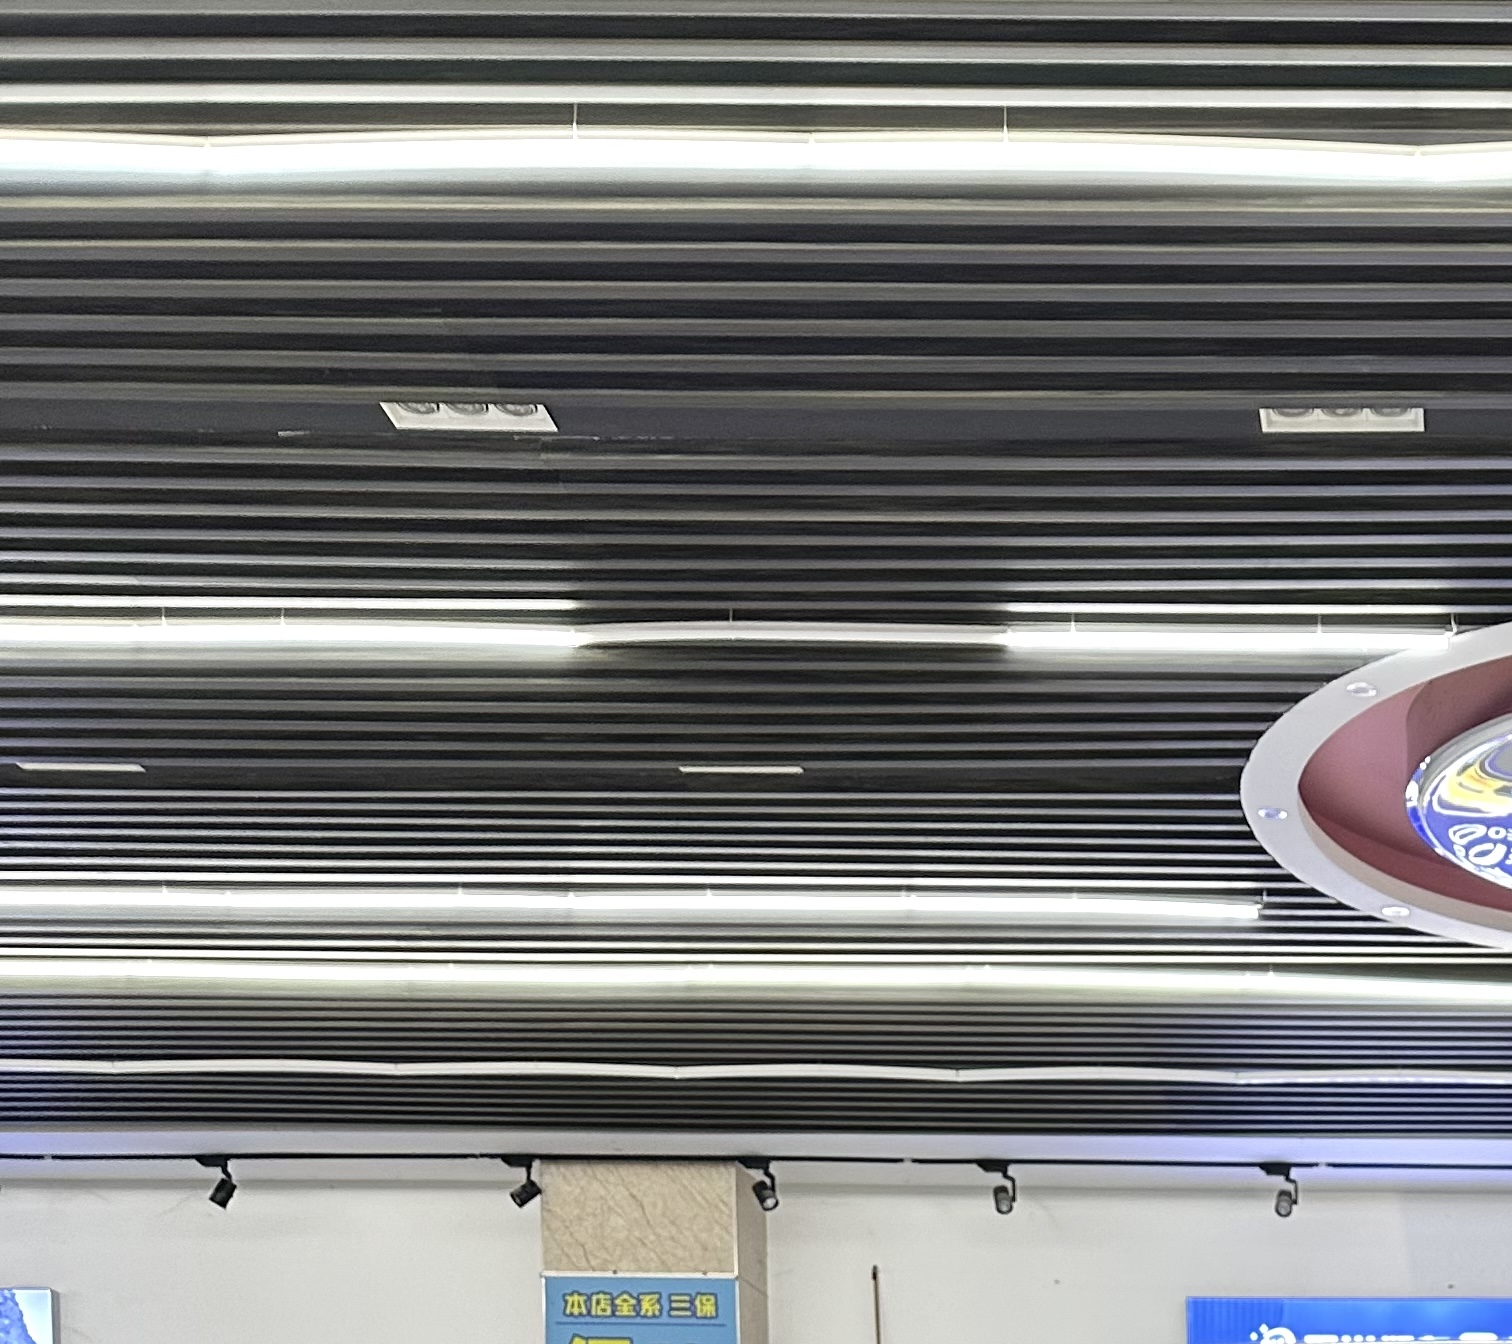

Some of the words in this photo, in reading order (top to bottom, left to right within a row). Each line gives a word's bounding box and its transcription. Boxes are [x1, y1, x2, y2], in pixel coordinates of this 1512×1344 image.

[563, 1291, 662, 1318] 本店全系
[668, 1292, 718, 1319] 三保
